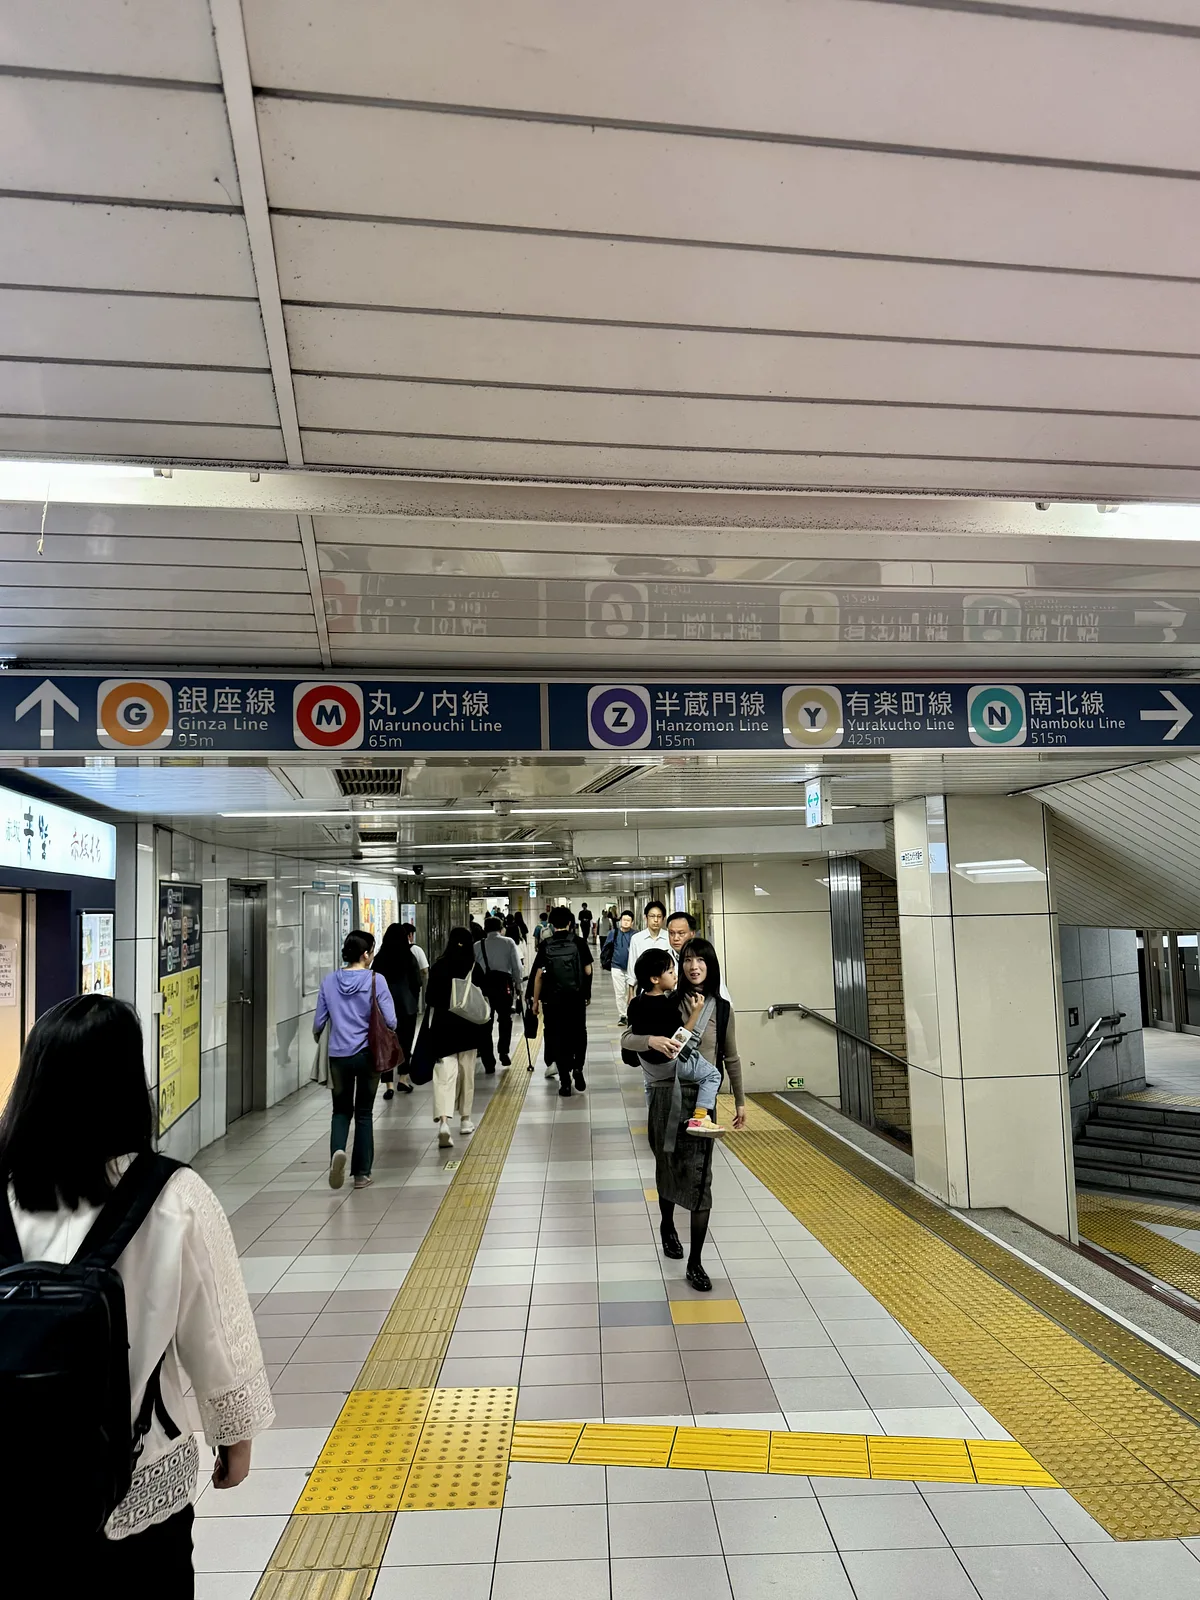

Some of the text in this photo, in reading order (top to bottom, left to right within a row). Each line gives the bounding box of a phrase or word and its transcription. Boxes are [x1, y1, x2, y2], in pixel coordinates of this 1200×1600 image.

[178, 687, 275, 715] 銀座線
[369, 689, 489, 716] 丸ノ内線
[656, 691, 765, 716] 半蔵門線
[846, 691, 952, 716] 有楽町線
[1030, 691, 1105, 715] 南北線
[124, 703, 147, 725] G
[316, 705, 342, 725] M
[612, 708, 628, 727] Z
[804, 708, 821, 726] Y
[988, 707, 1006, 725] N
[178, 717, 268, 730] Ginza Line
[370, 719, 501, 731] Marunouchi Line
[657, 719, 768, 731] Hanzomon Line
[848, 718, 954, 730] Yurakucho Line
[1031, 717, 1125, 729] Namboku Line
[178, 733, 214, 747] 95m
[369, 735, 401, 747] 65m
[657, 734, 695, 747] 155m
[848, 734, 884, 745] 425m
[1031, 733, 1067, 745] 515m
